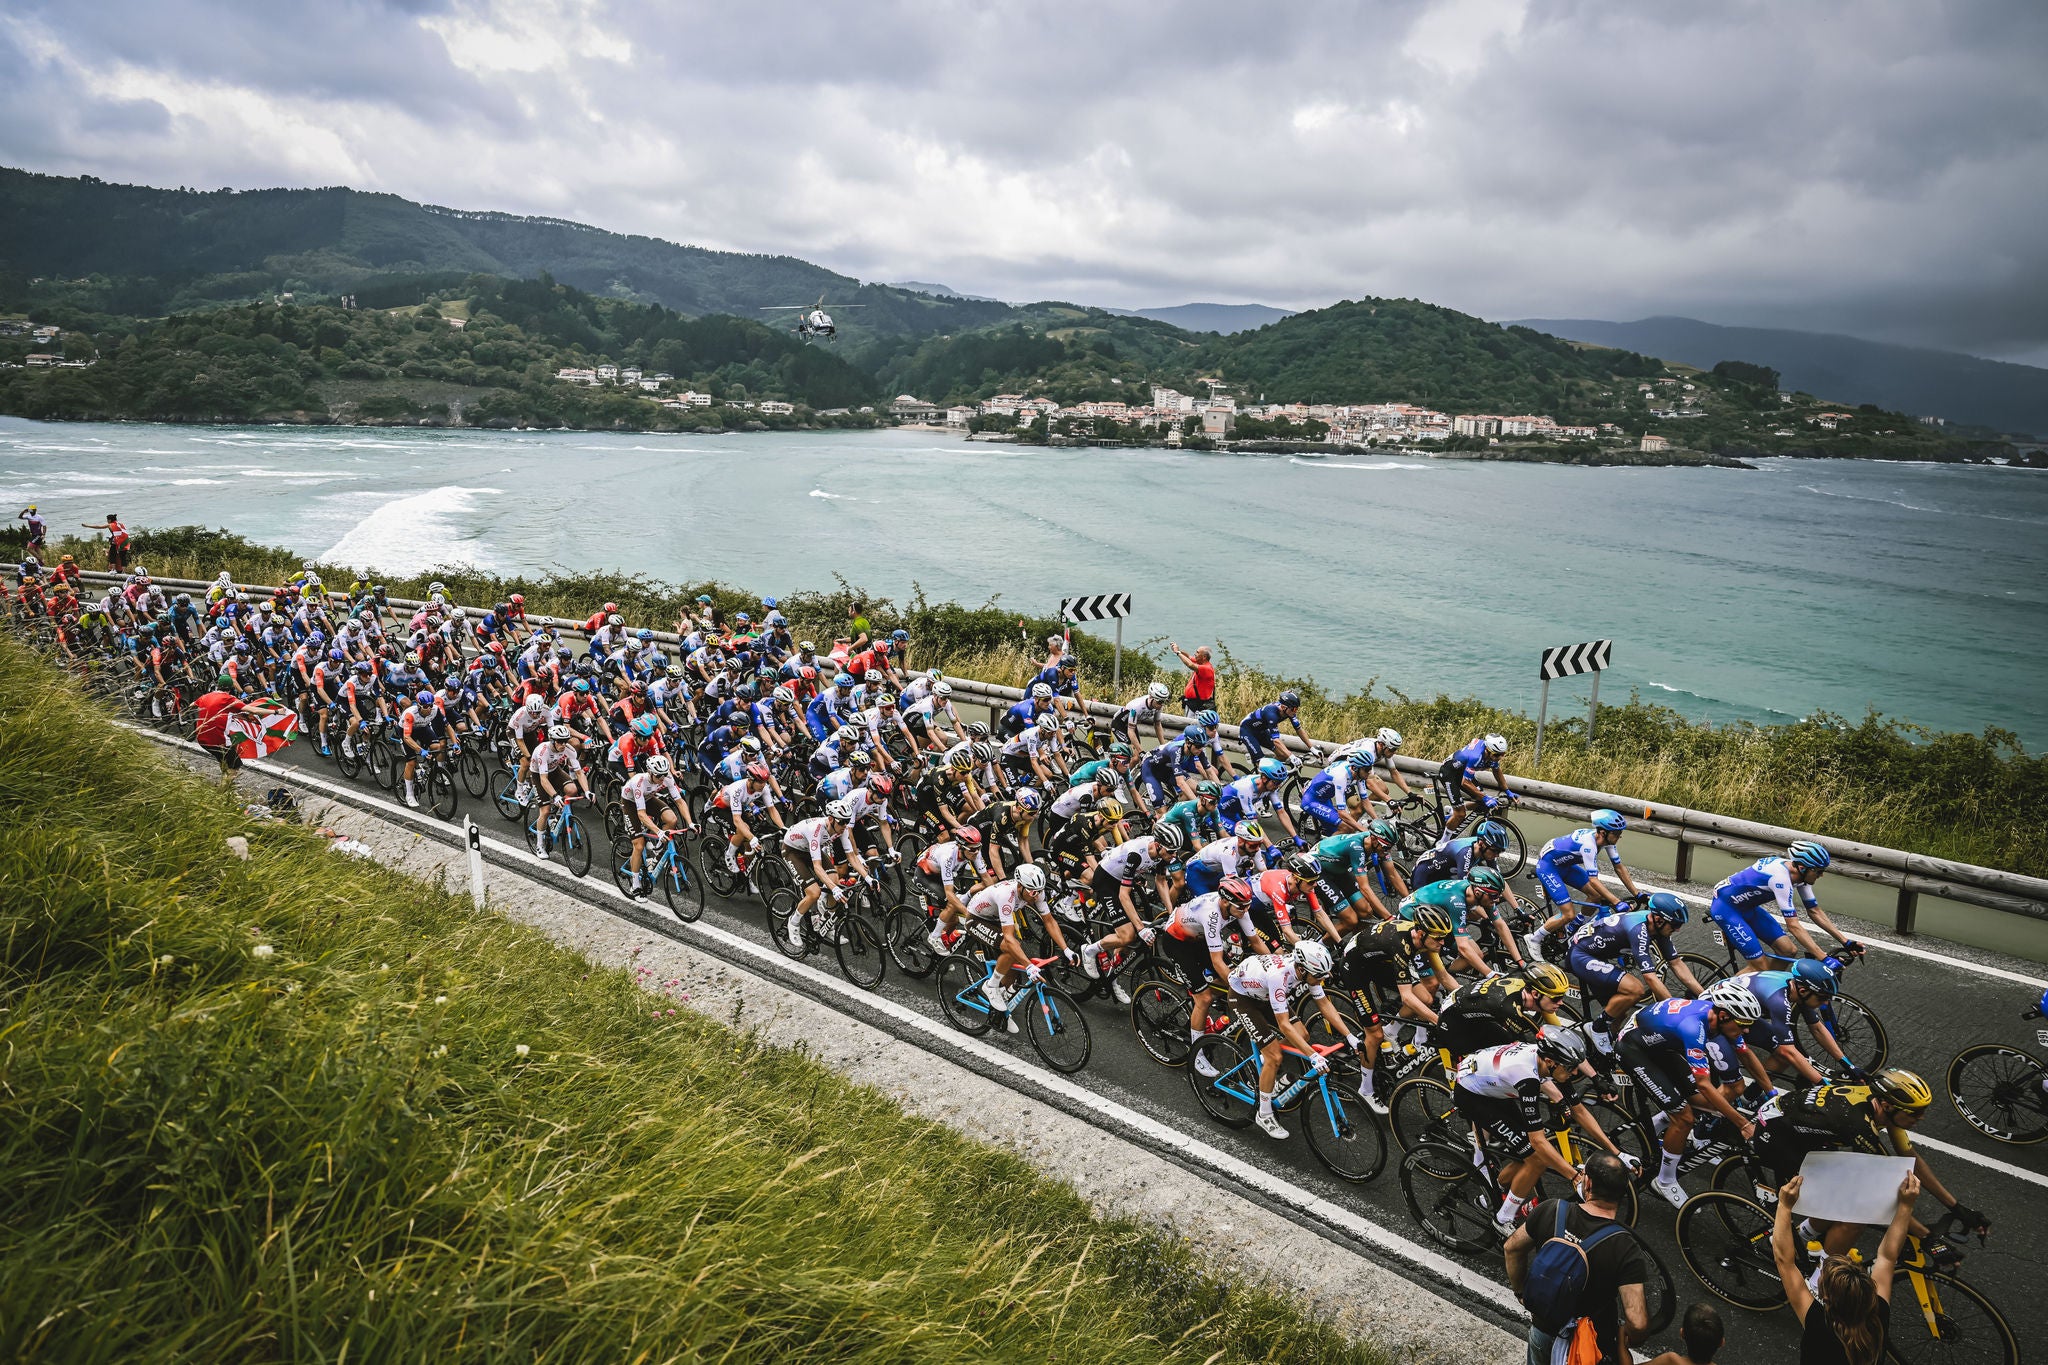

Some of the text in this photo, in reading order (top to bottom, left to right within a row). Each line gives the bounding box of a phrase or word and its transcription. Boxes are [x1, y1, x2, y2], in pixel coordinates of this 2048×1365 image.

[1005, 768, 1016, 784] BORA
[1060, 851, 1079, 862] JUMBO
[1552, 855, 1573, 866] Jayco
[1315, 879, 1340, 904] BORA
[1731, 890, 1762, 905] Jayco
[1106, 901, 1117, 917] UAE
[976, 922, 998, 941] AG2R LA
[1208, 911, 1219, 939] Cofidis
[969, 926, 995, 947] MONDIALE
[1713, 931, 1721, 943] 163
[1113, 951, 1137, 975] COLNAGO
[1356, 989, 1371, 1014] JUMBO
[1240, 1012, 1256, 1031] AG2R
[1252, 1029, 1263, 1041] LA
[1618, 1075, 1631, 1085] 102
[1633, 1066, 1672, 1105] deceuninck
[1953, 1092, 2012, 1140] CADEX
[1499, 1122, 1522, 1147] UAE
[1676, 1141, 1730, 1174] CANYON
[1763, 1191, 1769, 1201] 5
